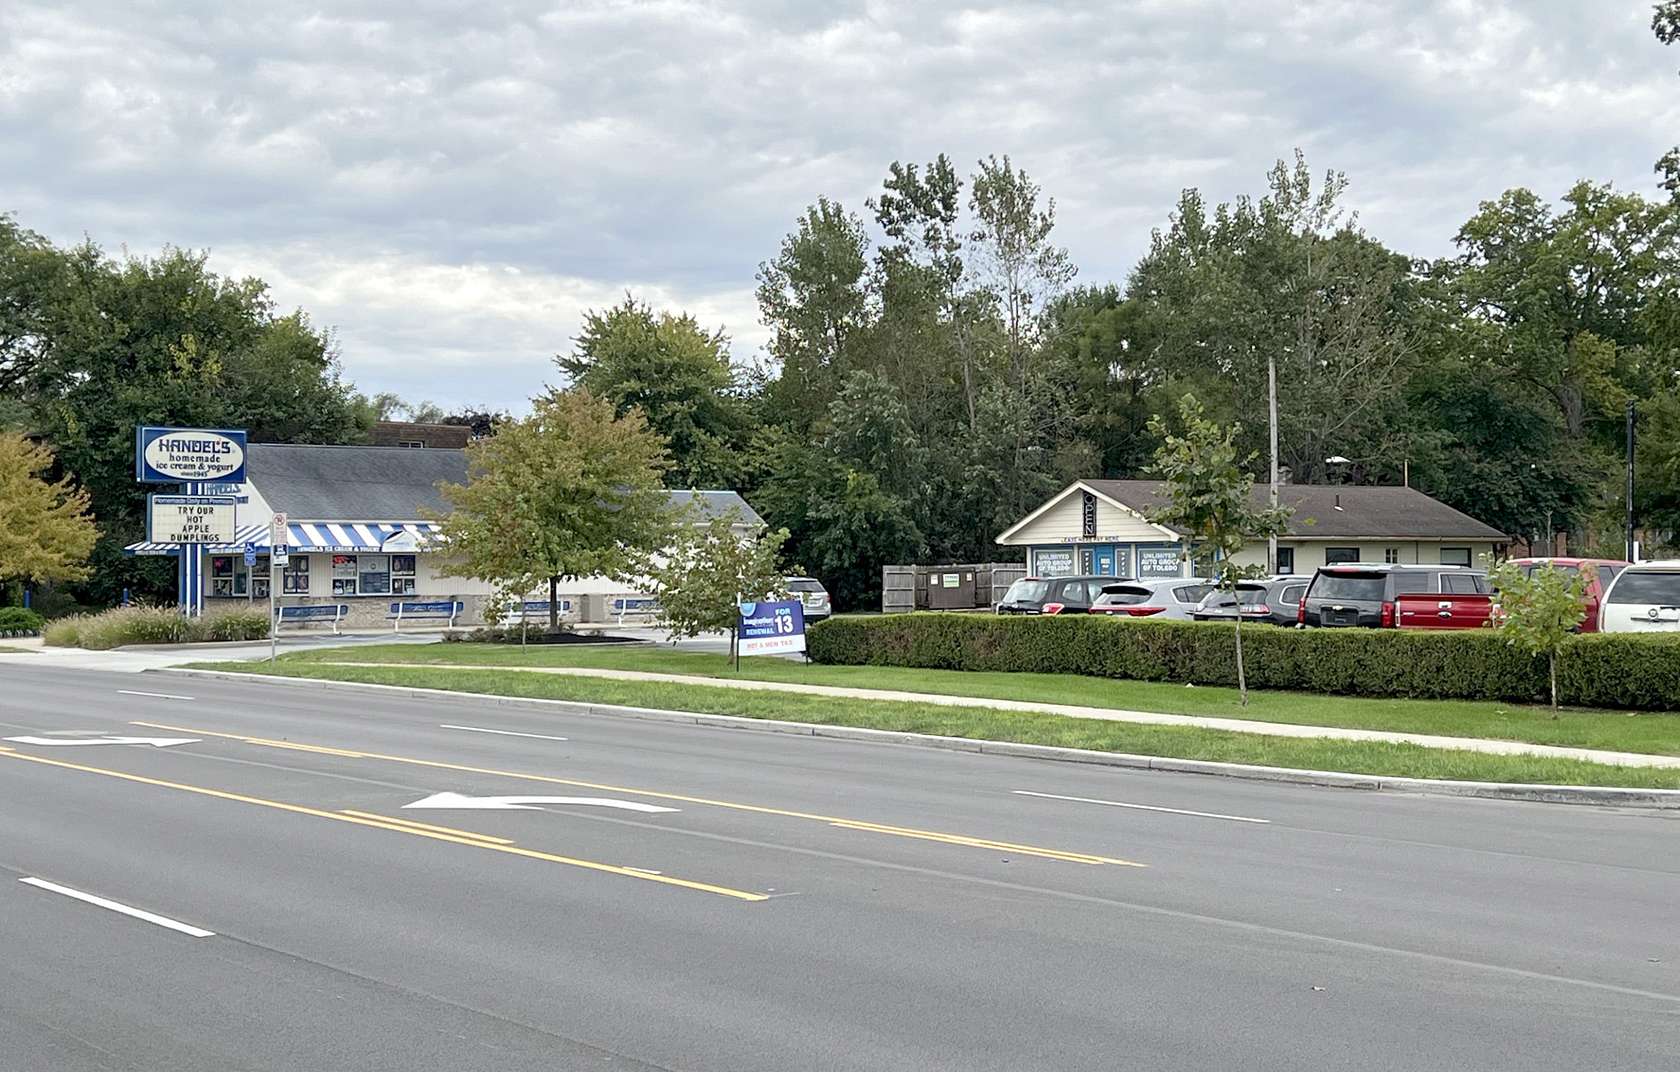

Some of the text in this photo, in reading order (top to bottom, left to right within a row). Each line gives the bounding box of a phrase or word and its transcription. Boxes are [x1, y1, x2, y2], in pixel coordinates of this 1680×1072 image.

[159, 439, 231, 453] HANDEL'S
[169, 454, 221, 463] homemade
[156, 462, 234, 472] ice cream & yogurt
[177, 506, 214, 514] TRY OUR
[1084, 493, 1095, 536] OPEN
[186, 516, 203, 524] HOT
[182, 525, 209, 533] APPLE
[170, 534, 220, 542] DUMPLINGS
[775, 608, 791, 616] FOR
[775, 615, 794, 634] 13
